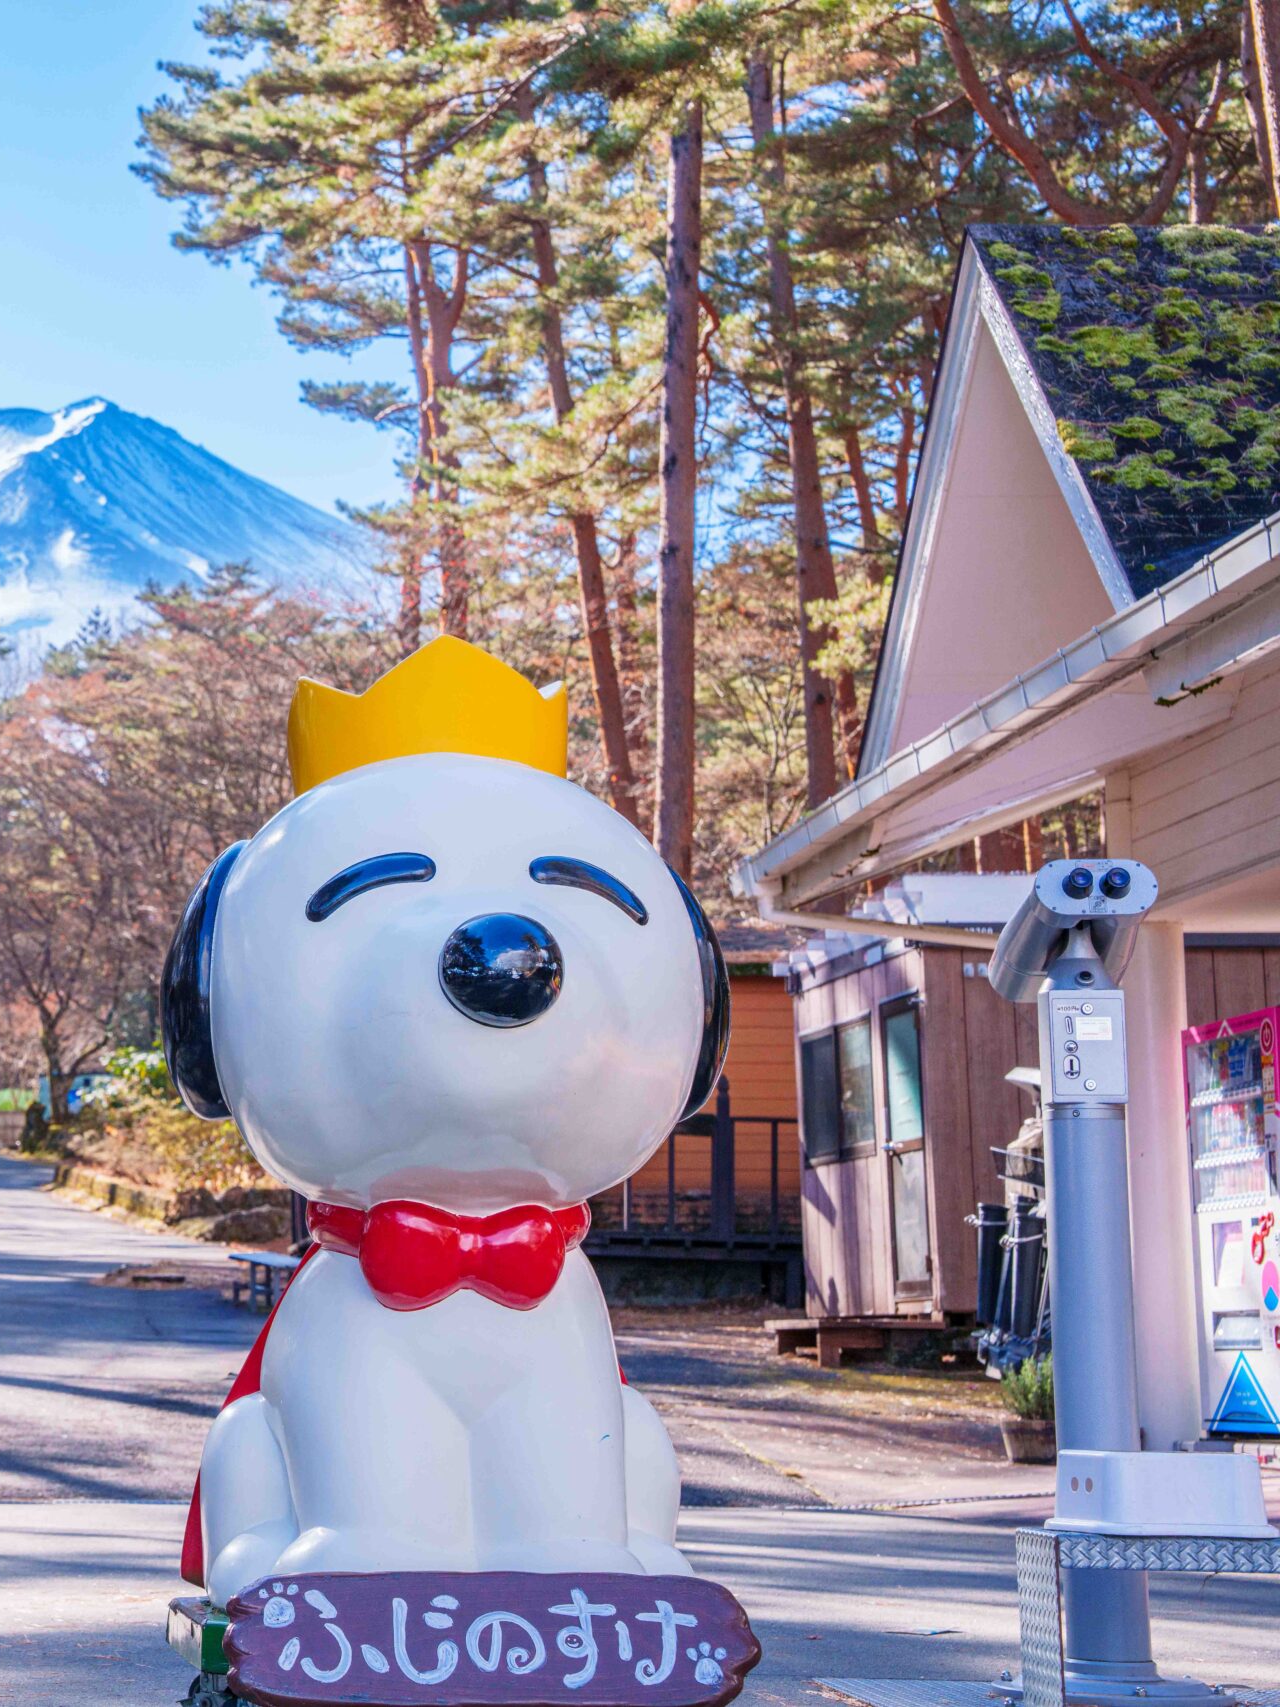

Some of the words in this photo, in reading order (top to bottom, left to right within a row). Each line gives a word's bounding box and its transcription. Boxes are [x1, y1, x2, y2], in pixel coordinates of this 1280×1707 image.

[278, 1587, 699, 1689] ふじのすけ
